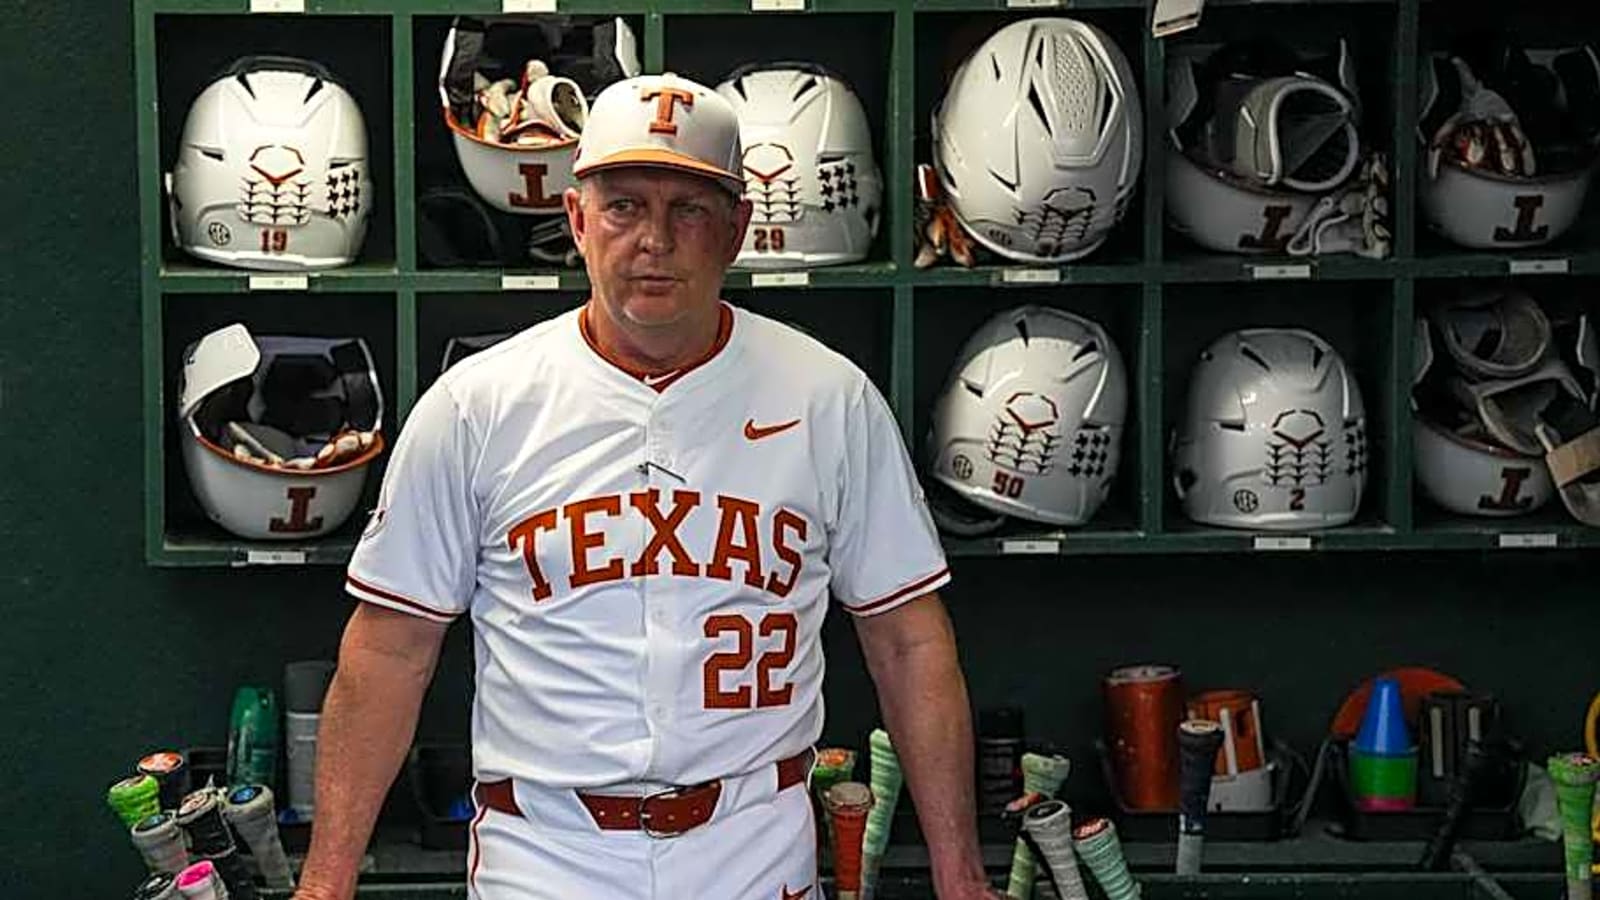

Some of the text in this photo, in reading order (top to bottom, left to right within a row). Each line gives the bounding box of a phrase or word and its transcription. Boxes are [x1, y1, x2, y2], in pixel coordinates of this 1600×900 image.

[641, 87, 694, 137] T
[260, 229, 287, 252] 19
[754, 228, 784, 253] 29
[992, 471, 1024, 499] 50
[1290, 489, 1305, 511] 2
[507, 488, 808, 602] TEXAS
[703, 613, 797, 710] 22
